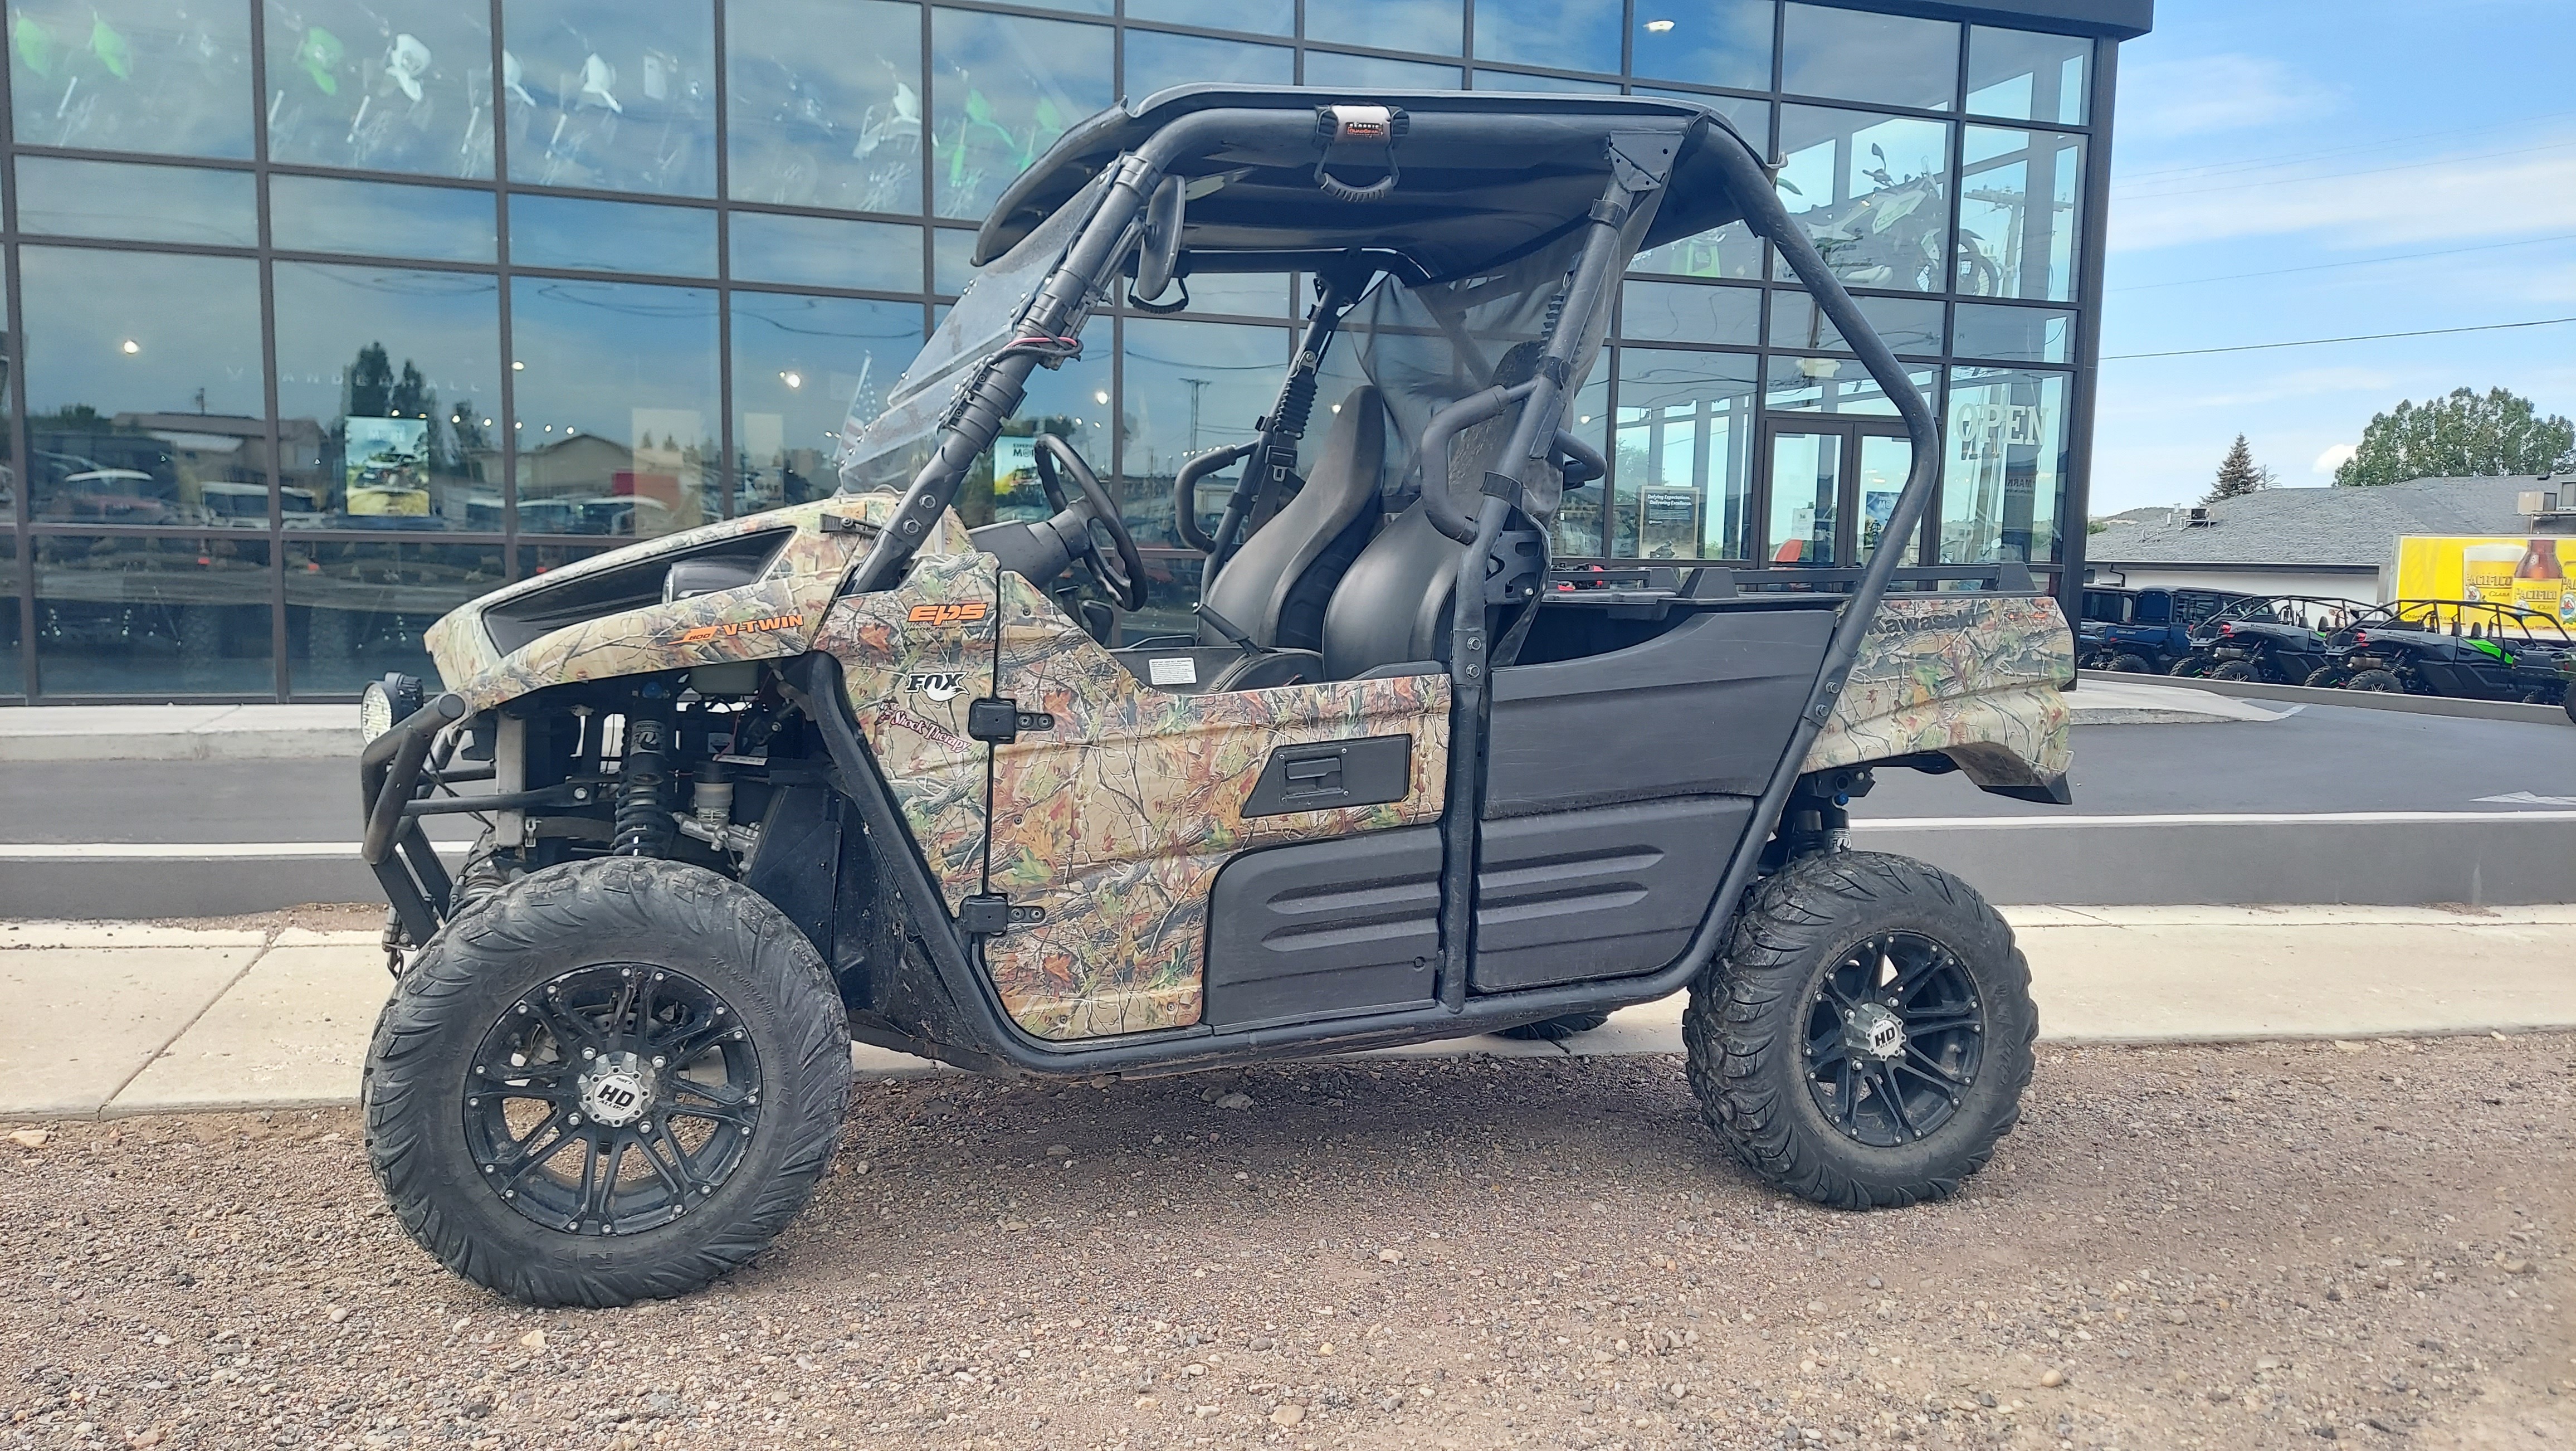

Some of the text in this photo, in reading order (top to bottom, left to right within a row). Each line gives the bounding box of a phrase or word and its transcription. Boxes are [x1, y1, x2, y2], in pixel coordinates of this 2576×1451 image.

[1956, 402, 2049, 445] OPEN
[723, 614, 803, 636] V-TWIN
[908, 603, 988, 626] EPS
[1867, 610, 1977, 635] Kawasaki
[905, 672, 969, 694] FOX
[890, 709, 973, 754] Shock Therapy
[1874, 1026, 1896, 1048] HD
[597, 1084, 635, 1107] HD
